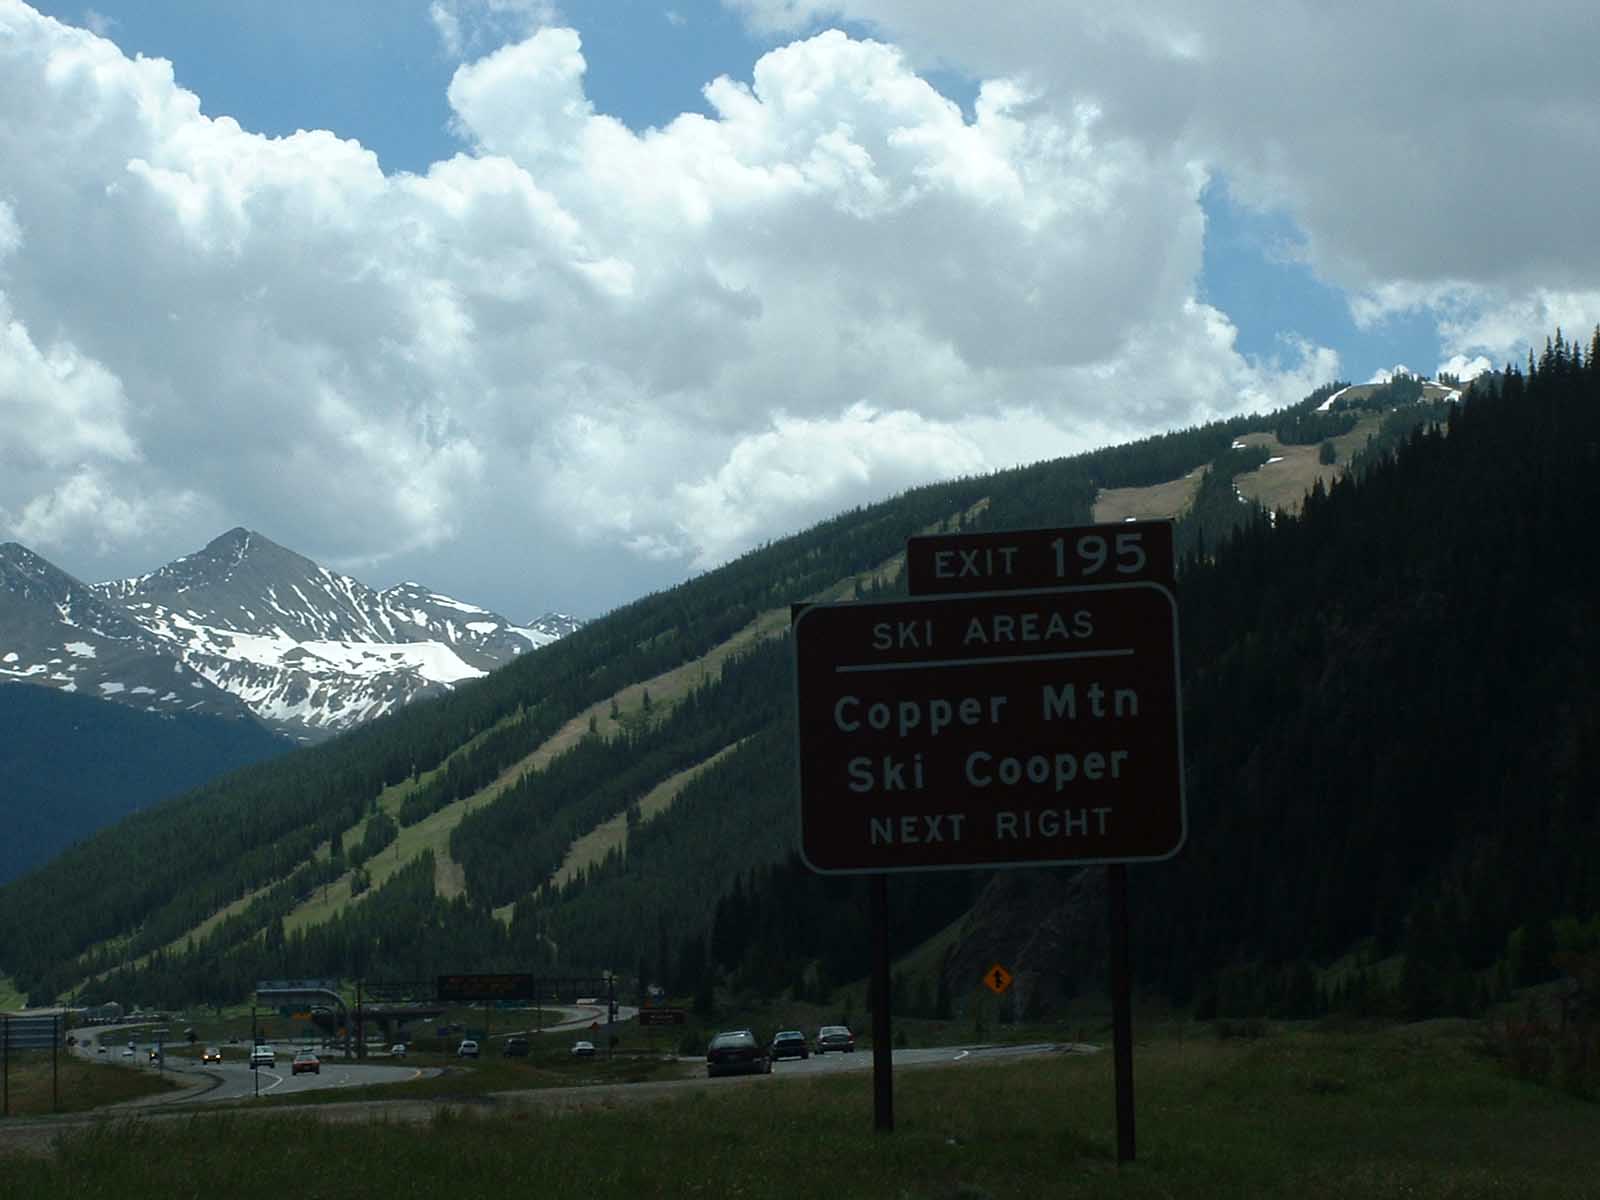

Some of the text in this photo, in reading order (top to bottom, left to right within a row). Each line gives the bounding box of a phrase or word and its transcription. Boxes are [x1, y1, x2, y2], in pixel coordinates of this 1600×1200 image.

[934, 533, 1147, 579] EXIT 195
[872, 610, 1095, 650] SKI AREAS
[833, 682, 1140, 736] Copper Mtn
[847, 748, 1129, 792] Ski Cooper
[870, 807, 1112, 845] NEXT RIGHT
